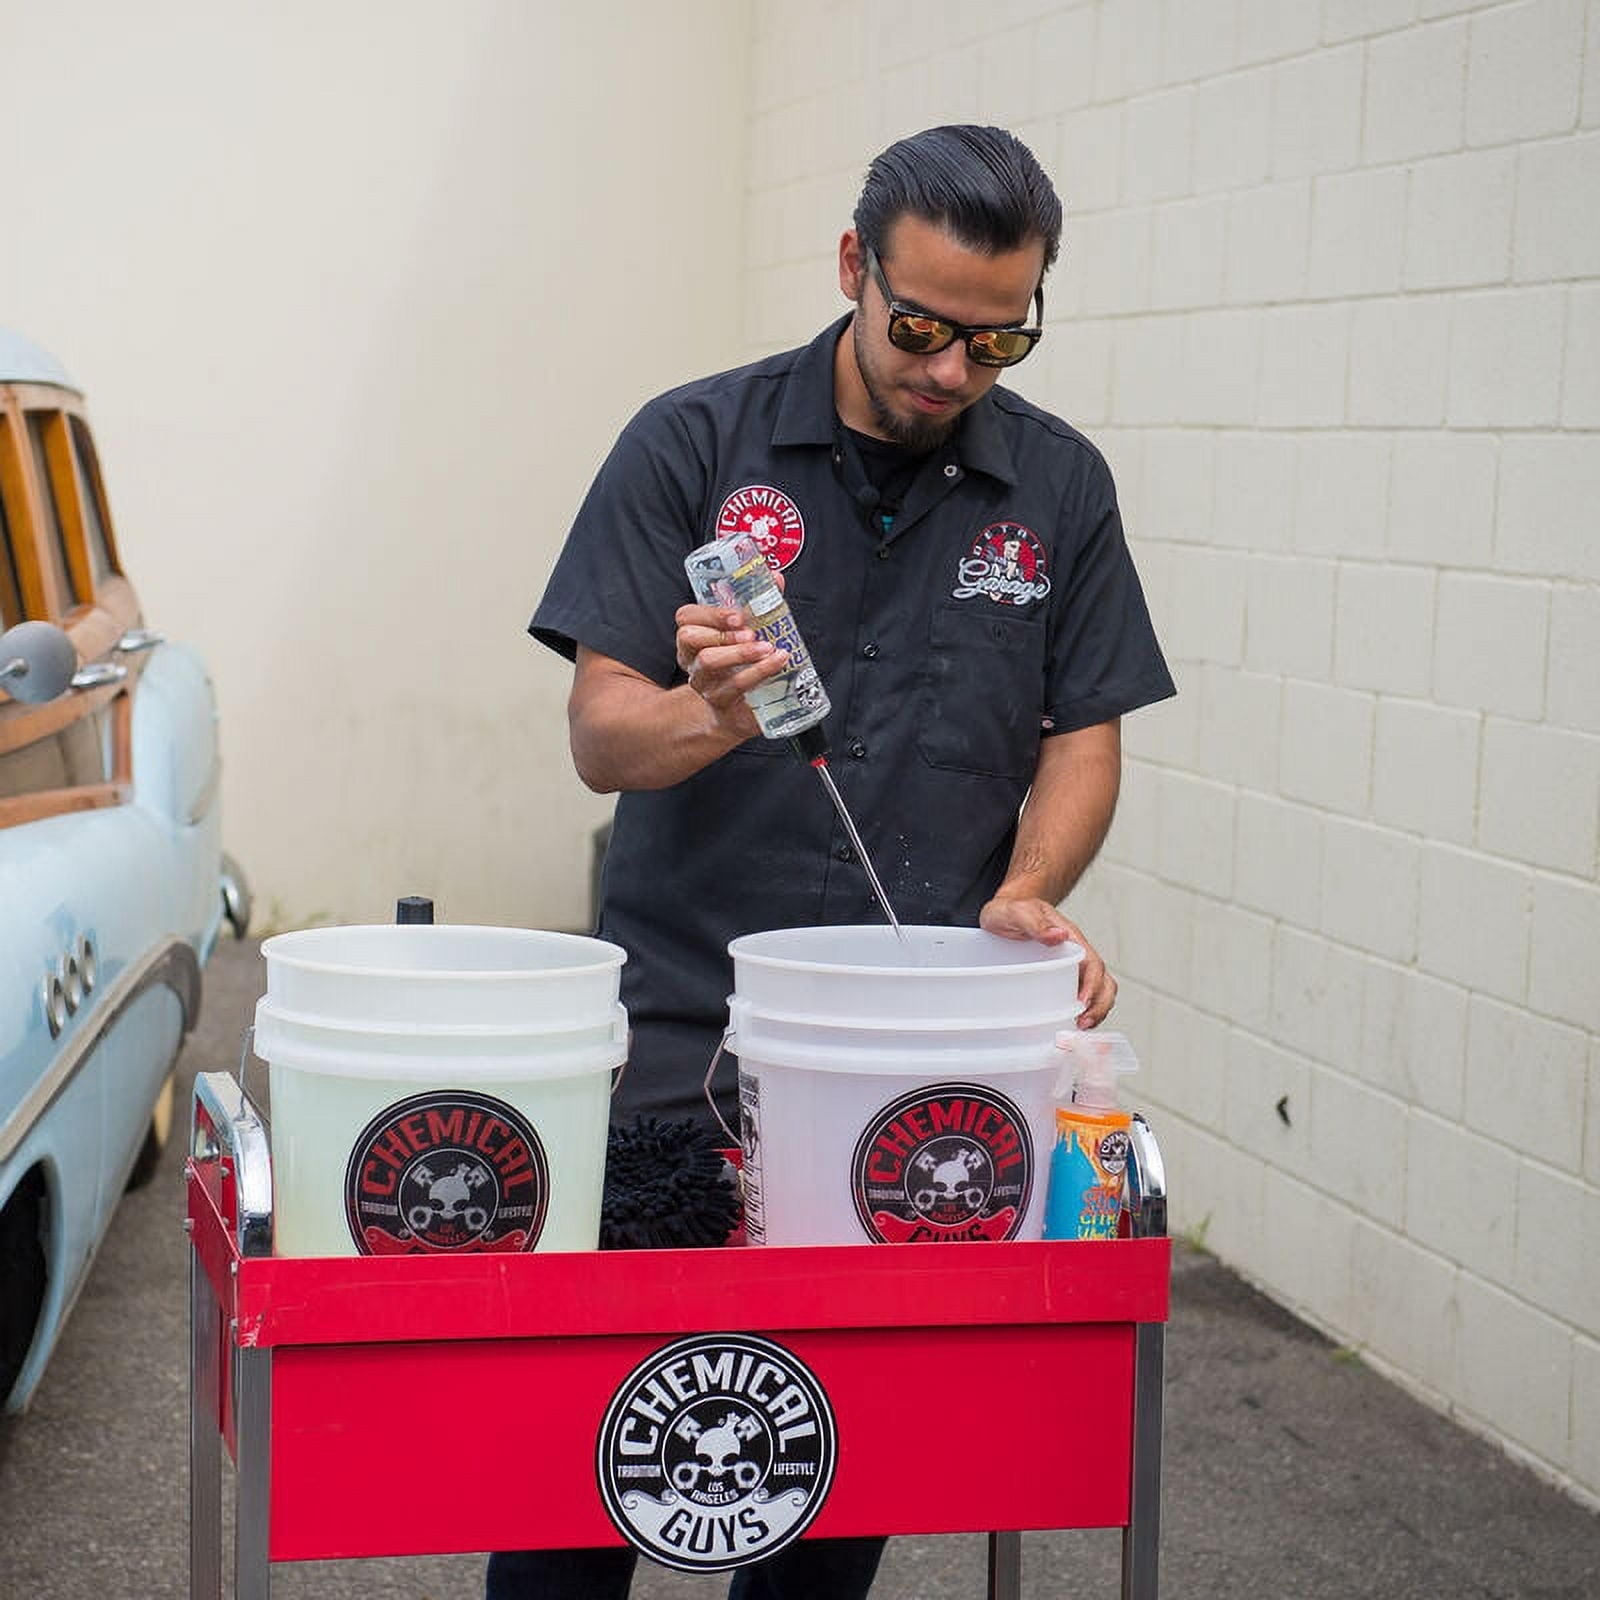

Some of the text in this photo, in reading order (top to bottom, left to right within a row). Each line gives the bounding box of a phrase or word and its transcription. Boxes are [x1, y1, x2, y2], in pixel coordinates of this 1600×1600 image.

[721, 489, 800, 533] CHEMICAL
[952, 557, 1051, 605] Garage
[362, 1109, 535, 1200] CHEMICAL
[867, 1099, 1023, 1183] CHEMICAL
[619, 1351, 817, 1455] CHEMICAL
[658, 1507, 770, 1554] GUYS
